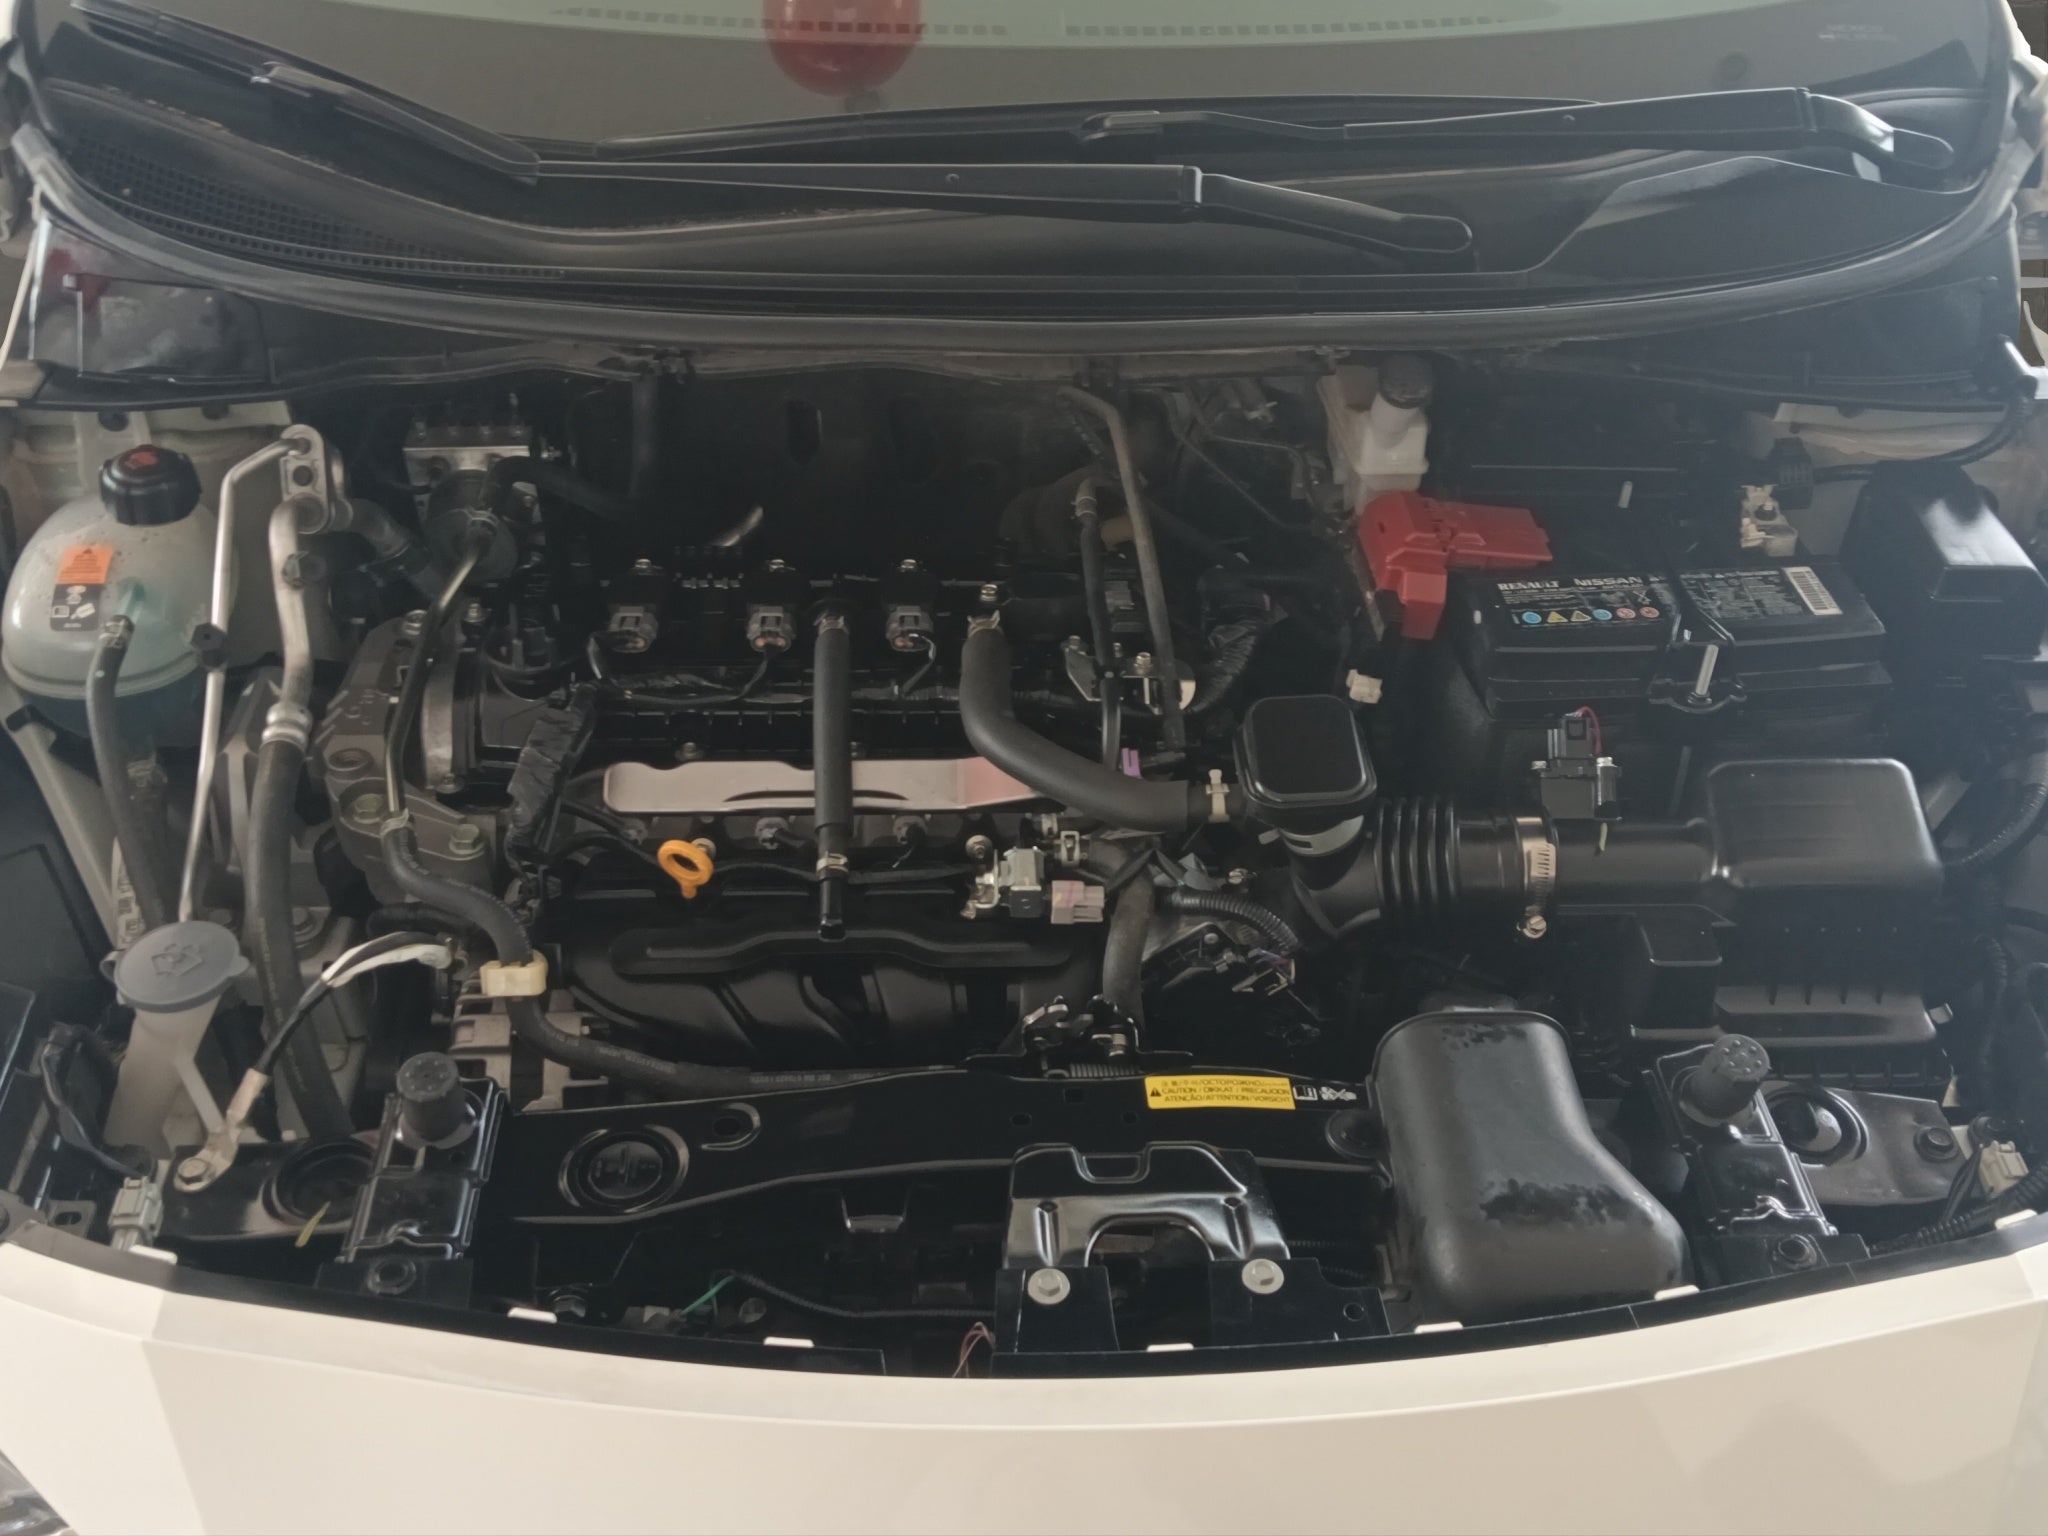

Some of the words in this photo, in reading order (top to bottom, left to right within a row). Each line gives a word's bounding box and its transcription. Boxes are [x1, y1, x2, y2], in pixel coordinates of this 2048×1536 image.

[1497, 579, 1560, 591] RENAULT
[1574, 576, 1644, 587] NISSAN
[1162, 1087, 1197, 1095] CAUTION
